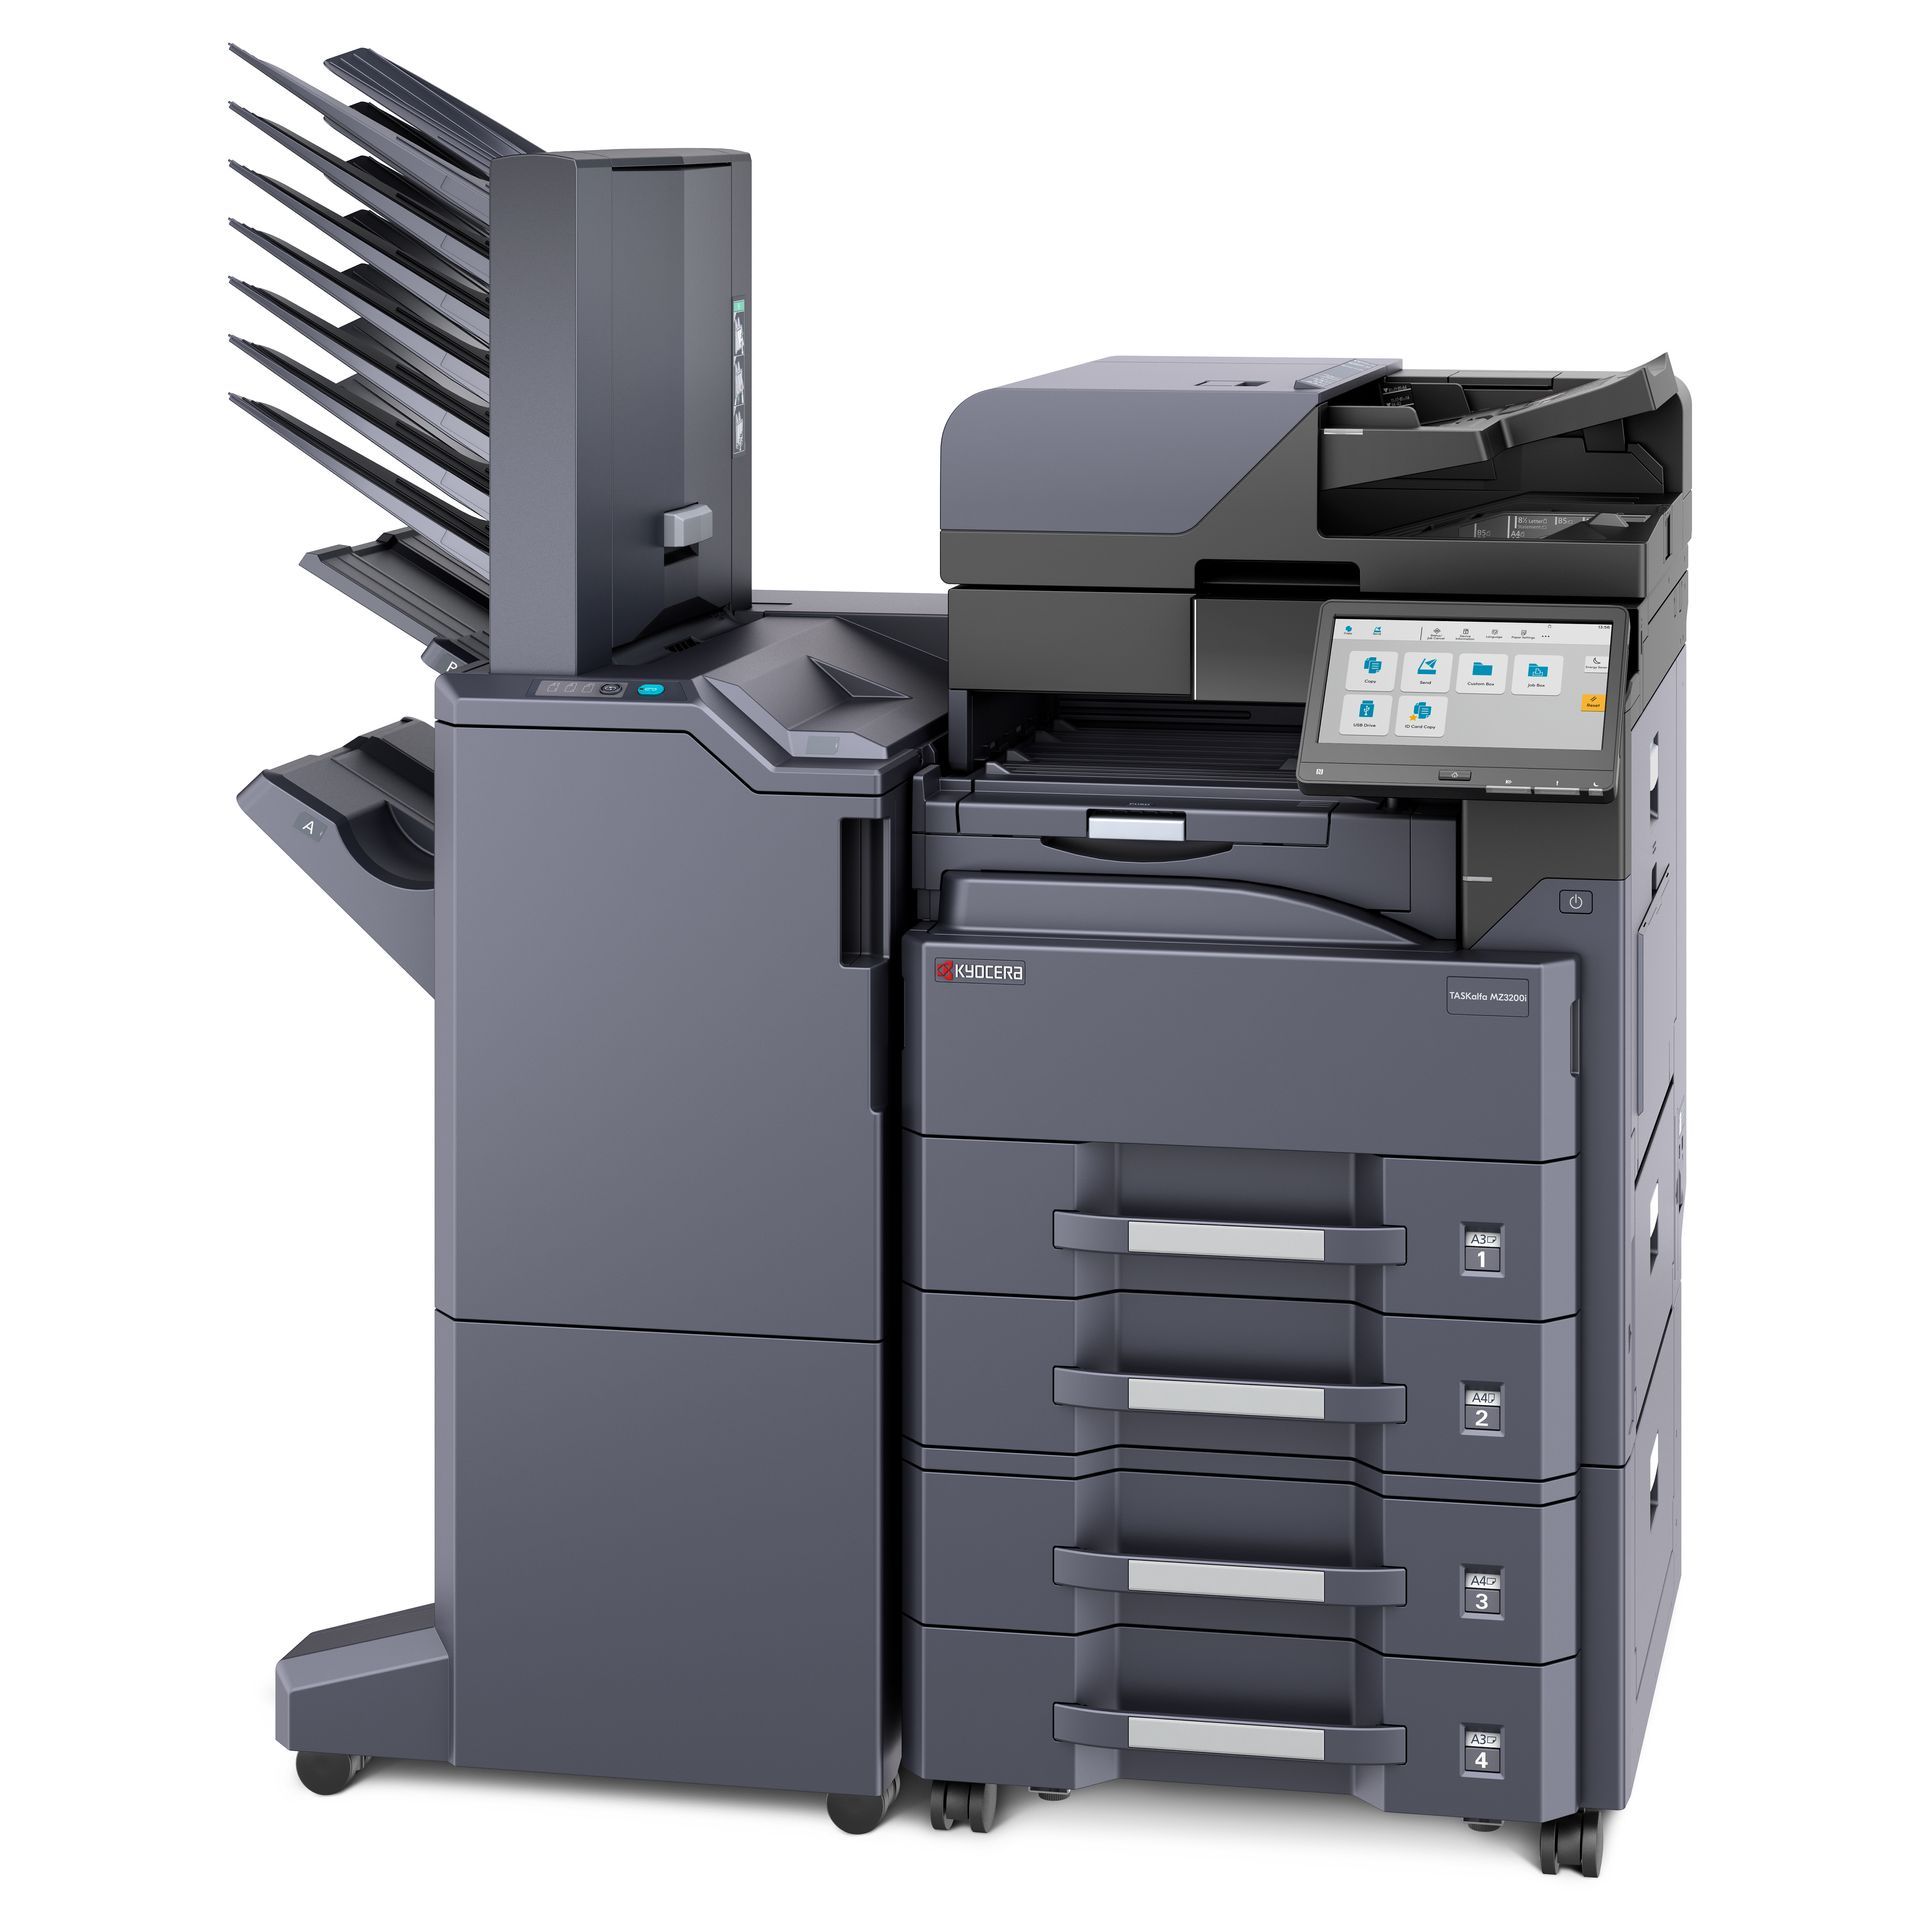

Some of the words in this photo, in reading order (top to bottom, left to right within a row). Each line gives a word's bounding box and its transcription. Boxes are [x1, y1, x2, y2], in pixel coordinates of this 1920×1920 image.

[1510, 529, 1521, 538] A4
[446, 661, 458, 672] P
[302, 820, 314, 835] A
[955, 964, 1023, 980] KYOCERA
[1449, 991, 1488, 1001] TASKalfa
[1490, 993, 1527, 1002] MZ3200i
[1470, 1234, 1486, 1244] A3
[1477, 1250, 1485, 1268] 1
[1472, 1392, 1488, 1403] A4
[1475, 1410, 1488, 1427] 2
[1470, 1576, 1486, 1586] A4
[1475, 1593, 1488, 1610] 3
[1470, 1734, 1486, 1745] A3
[1474, 1752, 1488, 1769] 4
